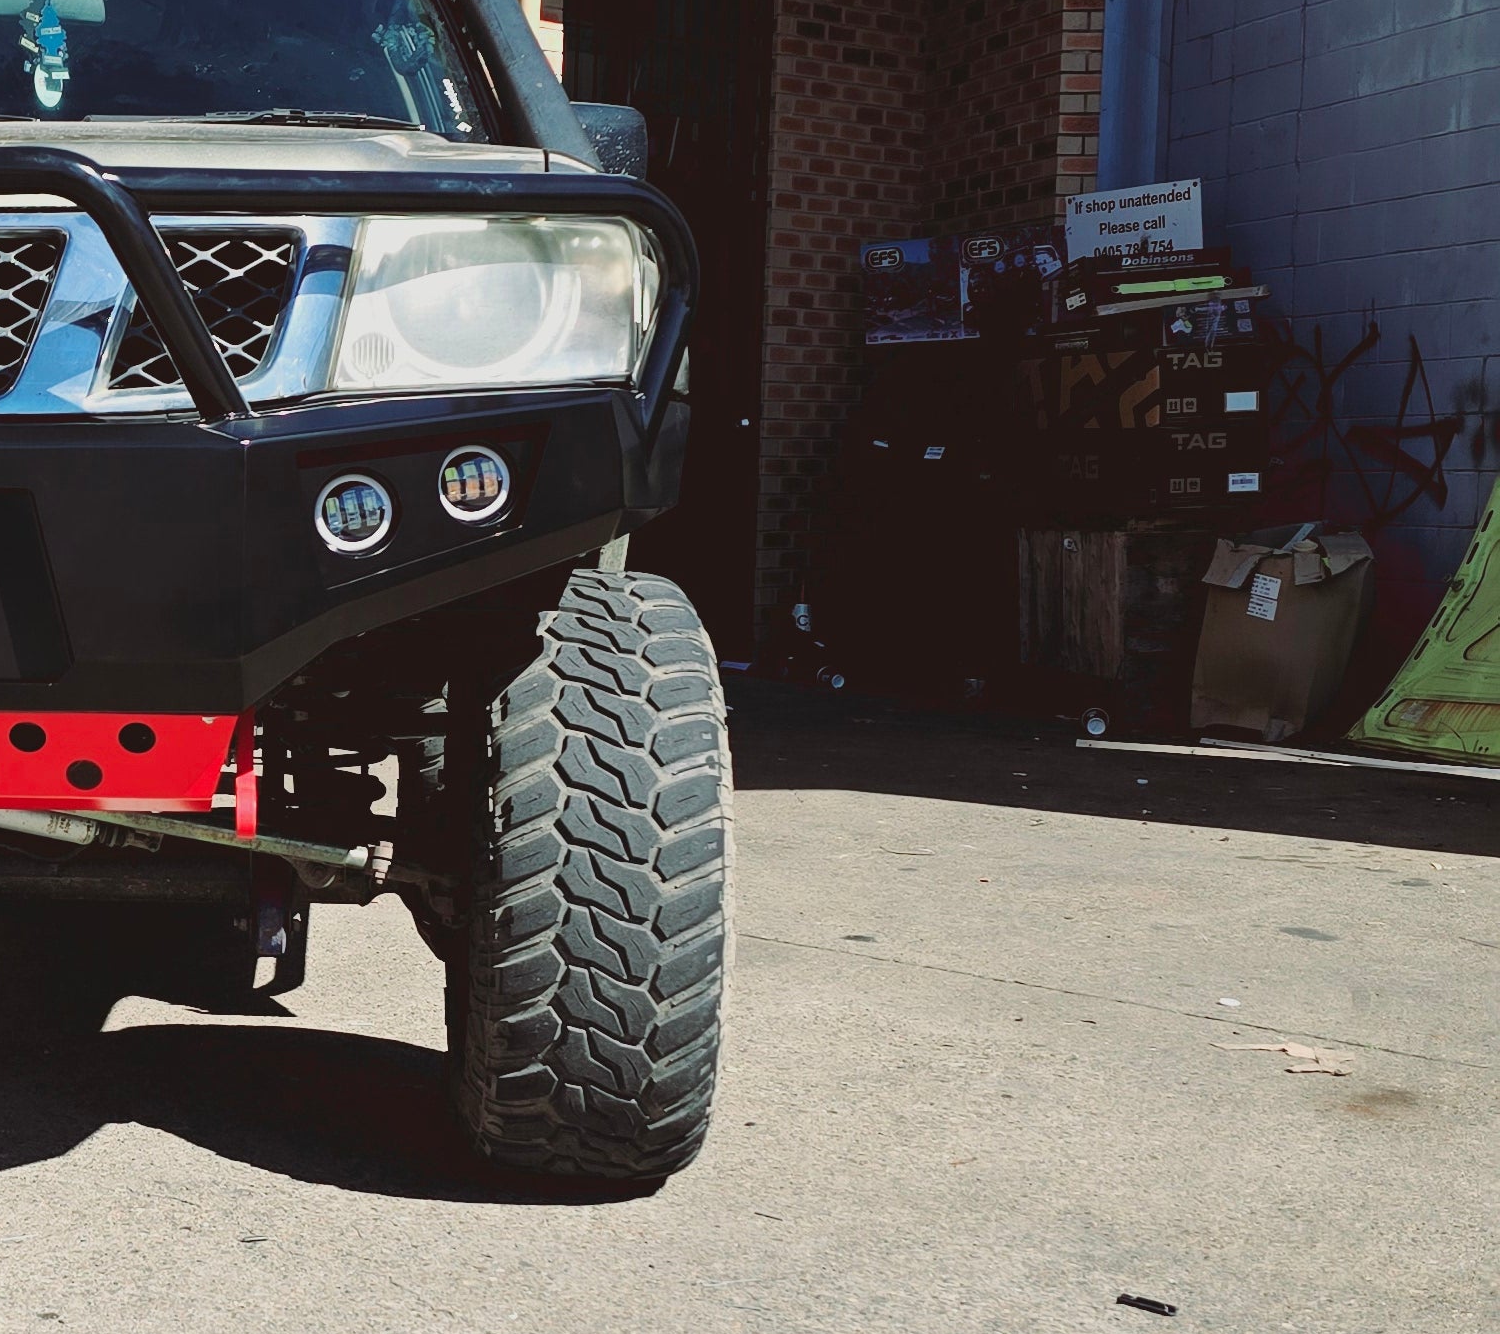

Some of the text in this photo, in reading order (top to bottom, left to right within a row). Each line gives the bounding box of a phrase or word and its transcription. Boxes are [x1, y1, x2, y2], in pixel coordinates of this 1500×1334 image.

[1074, 187, 1191, 215] If shop unattended
[1099, 215, 1166, 235] Please call
[967, 240, 999, 257] EFS
[1150, 238, 1174, 253] 754
[869, 249, 899, 266] EFS
[1121, 253, 1195, 267] Dobinsons
[1166, 351, 1223, 371] TAG
[1171, 433, 1227, 451] TAG
